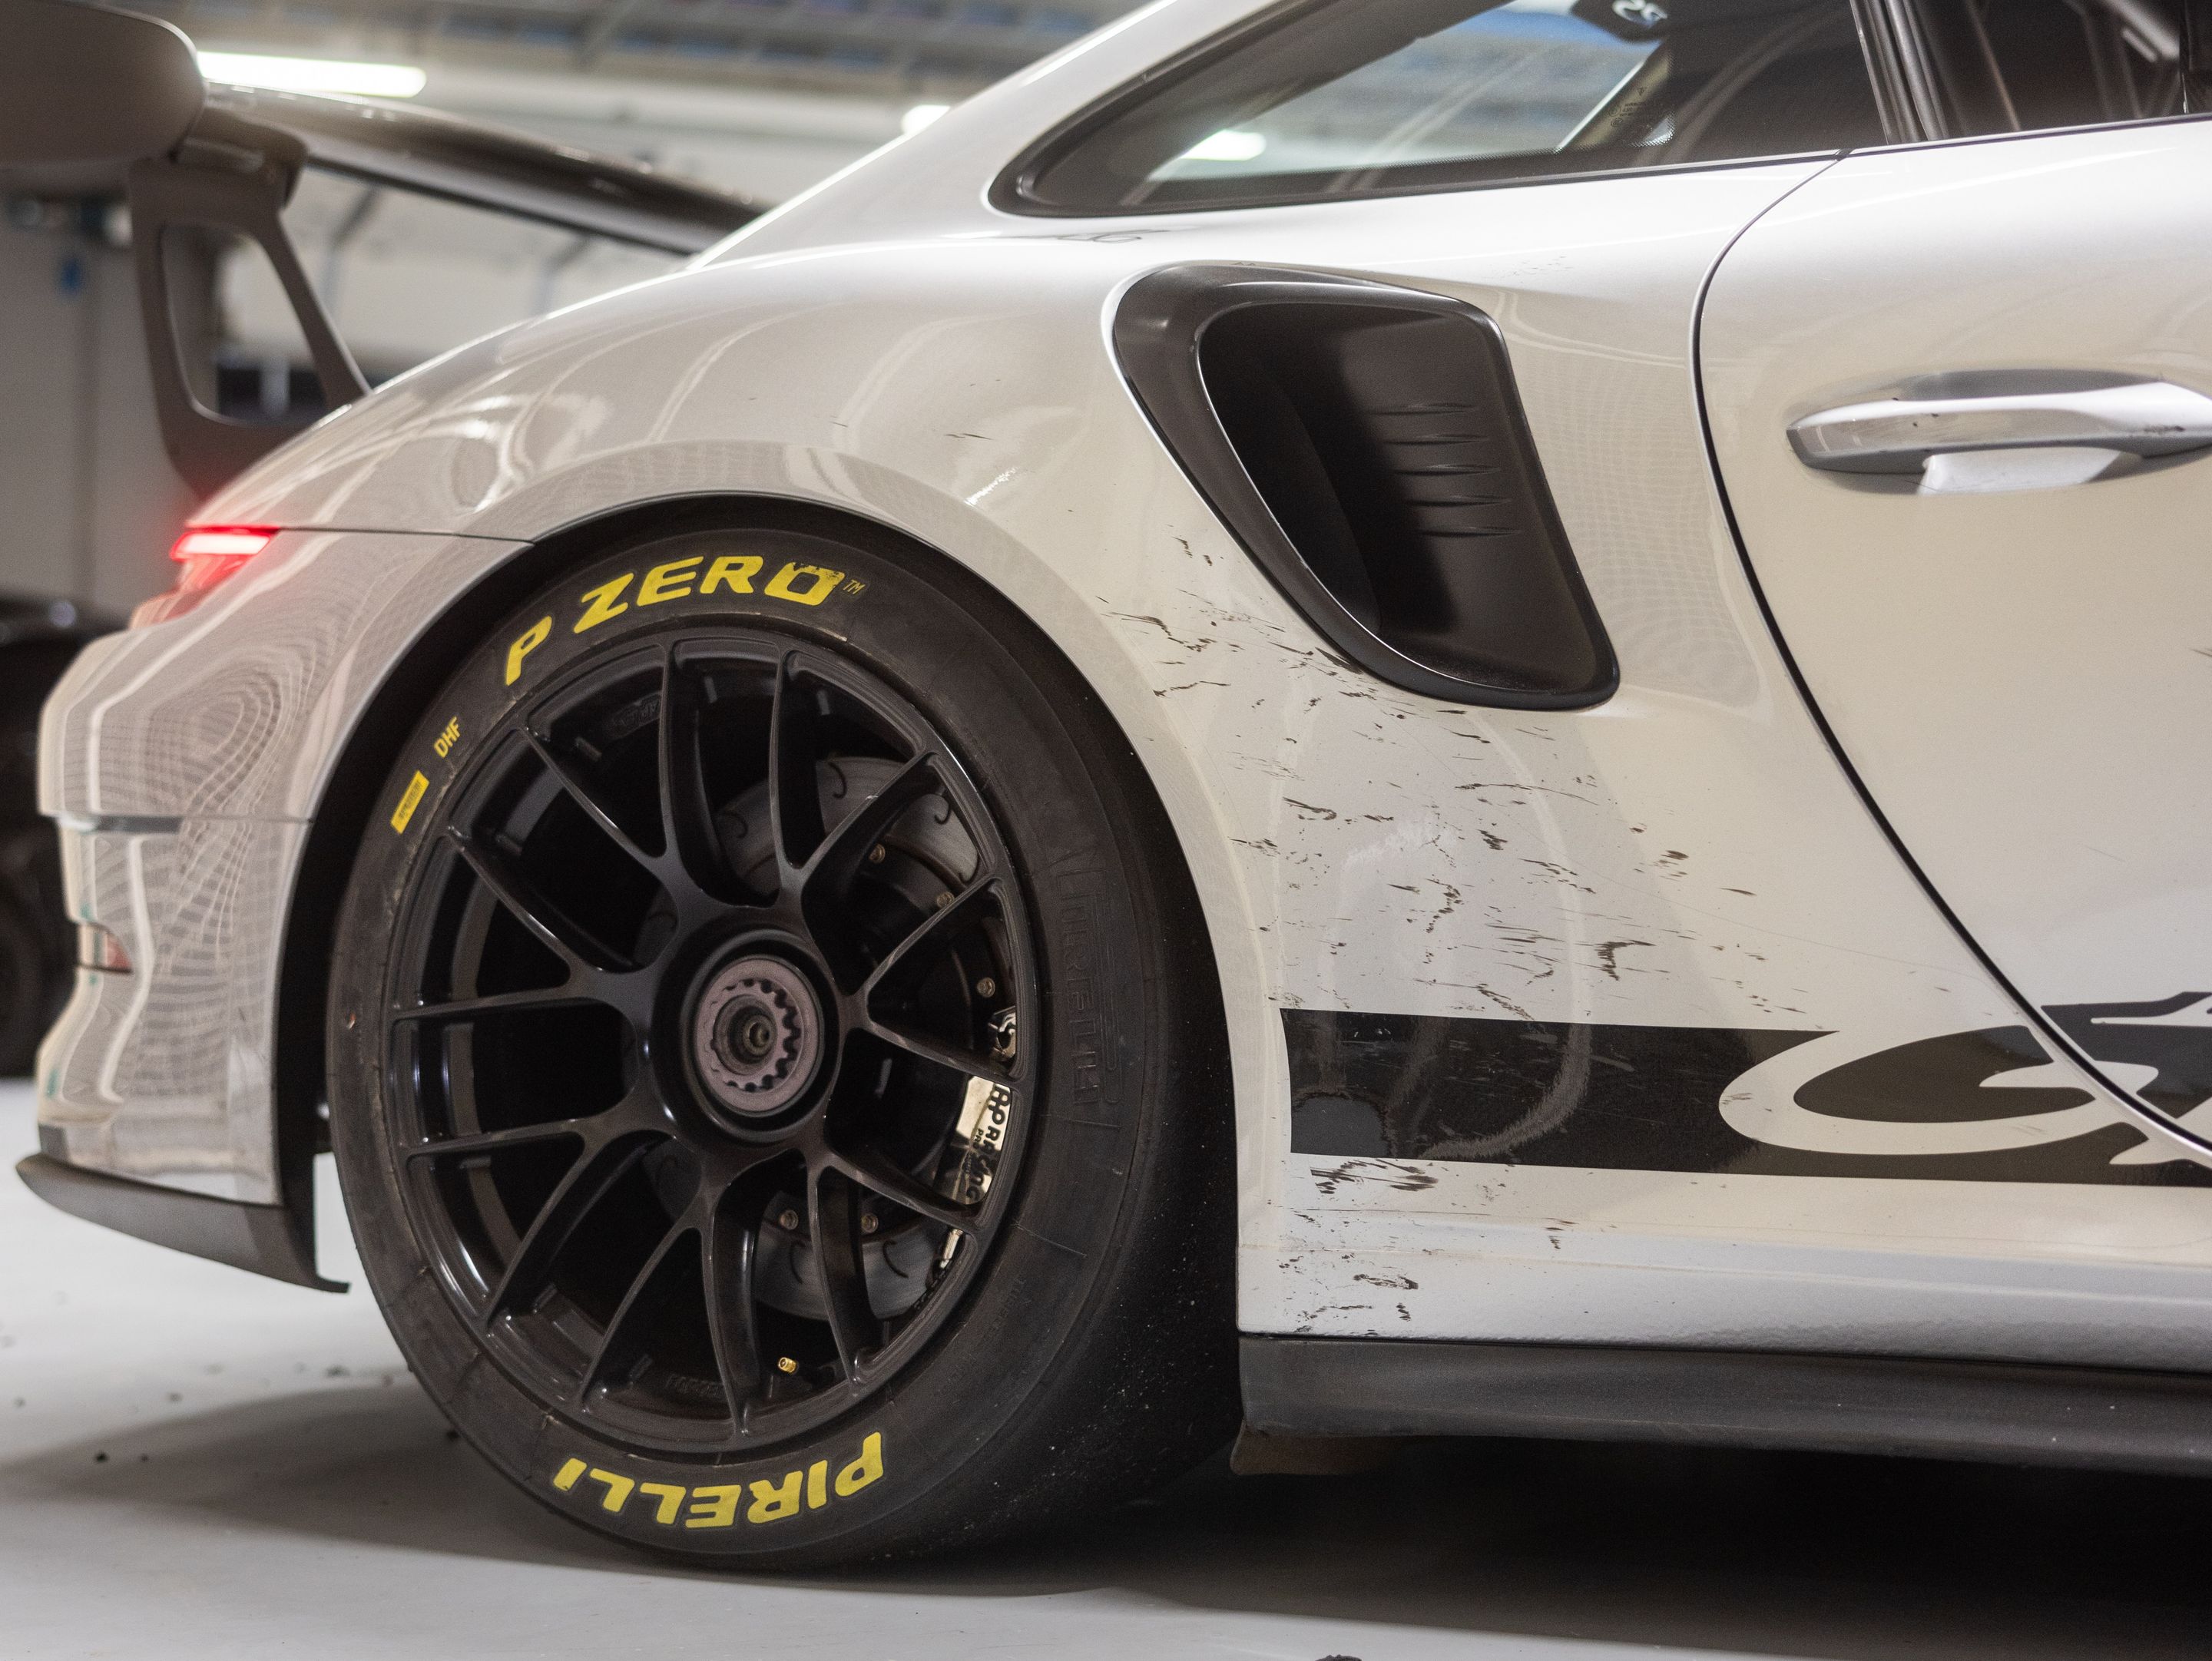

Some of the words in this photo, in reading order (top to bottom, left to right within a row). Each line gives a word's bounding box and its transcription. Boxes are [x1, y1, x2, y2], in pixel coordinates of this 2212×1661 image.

[505, 615, 553, 687] P
[572, 555, 846, 634] ZERO
[433, 716, 461, 759] DHF
[552, 1431, 884, 1529] PIRELLI
